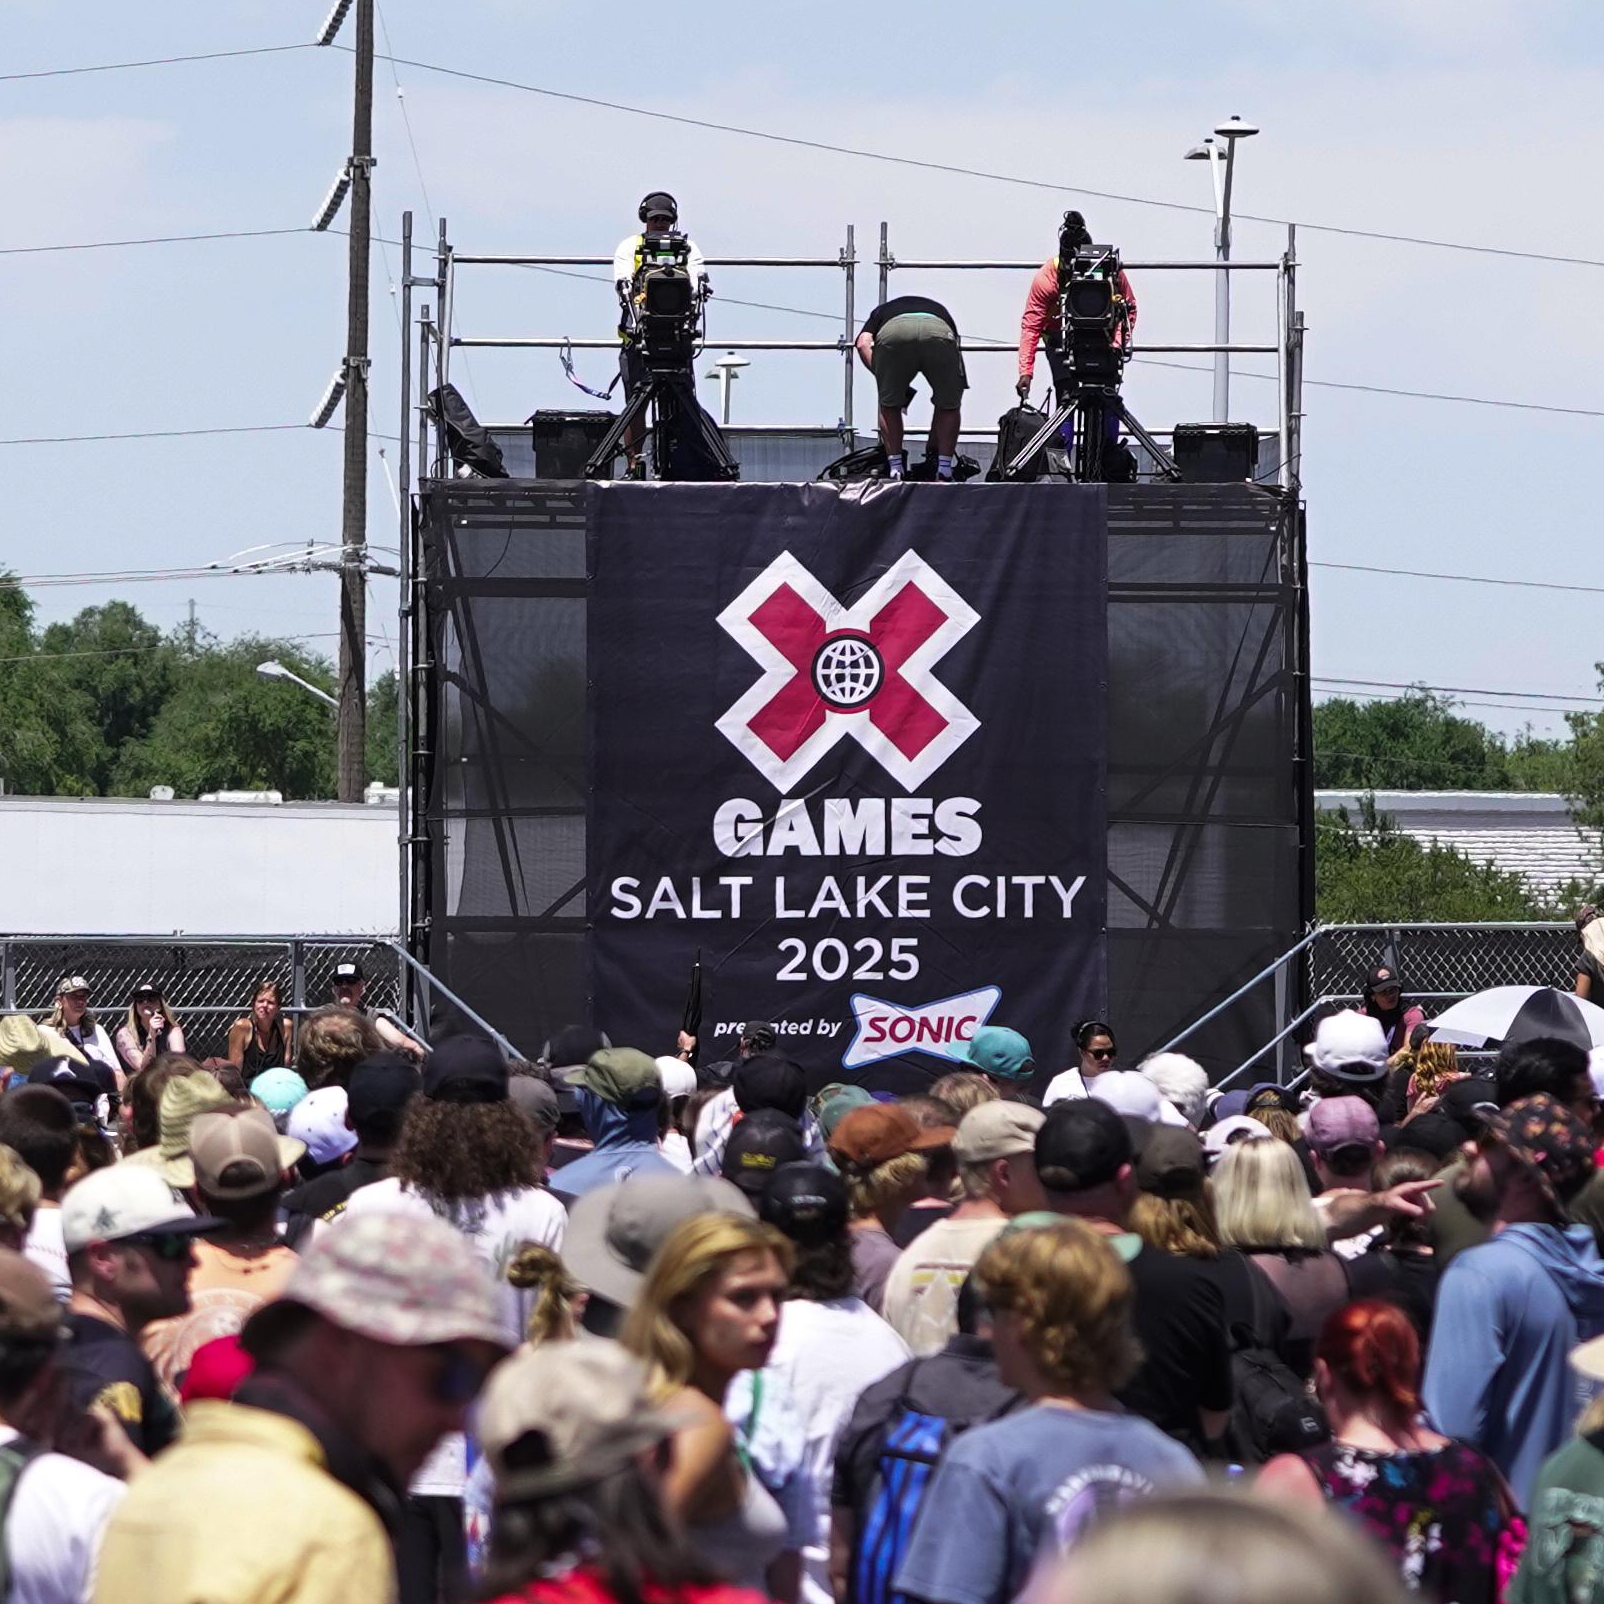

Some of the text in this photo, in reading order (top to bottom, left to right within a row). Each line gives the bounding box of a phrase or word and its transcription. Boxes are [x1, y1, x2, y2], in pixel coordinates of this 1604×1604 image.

[713, 796, 983, 858] GAMES
[609, 874, 1087, 919] SALT LAKE CITY
[775, 937, 921, 981] 2025
[816, 1018, 843, 1038] by
[863, 1015, 978, 1044] SONIC
